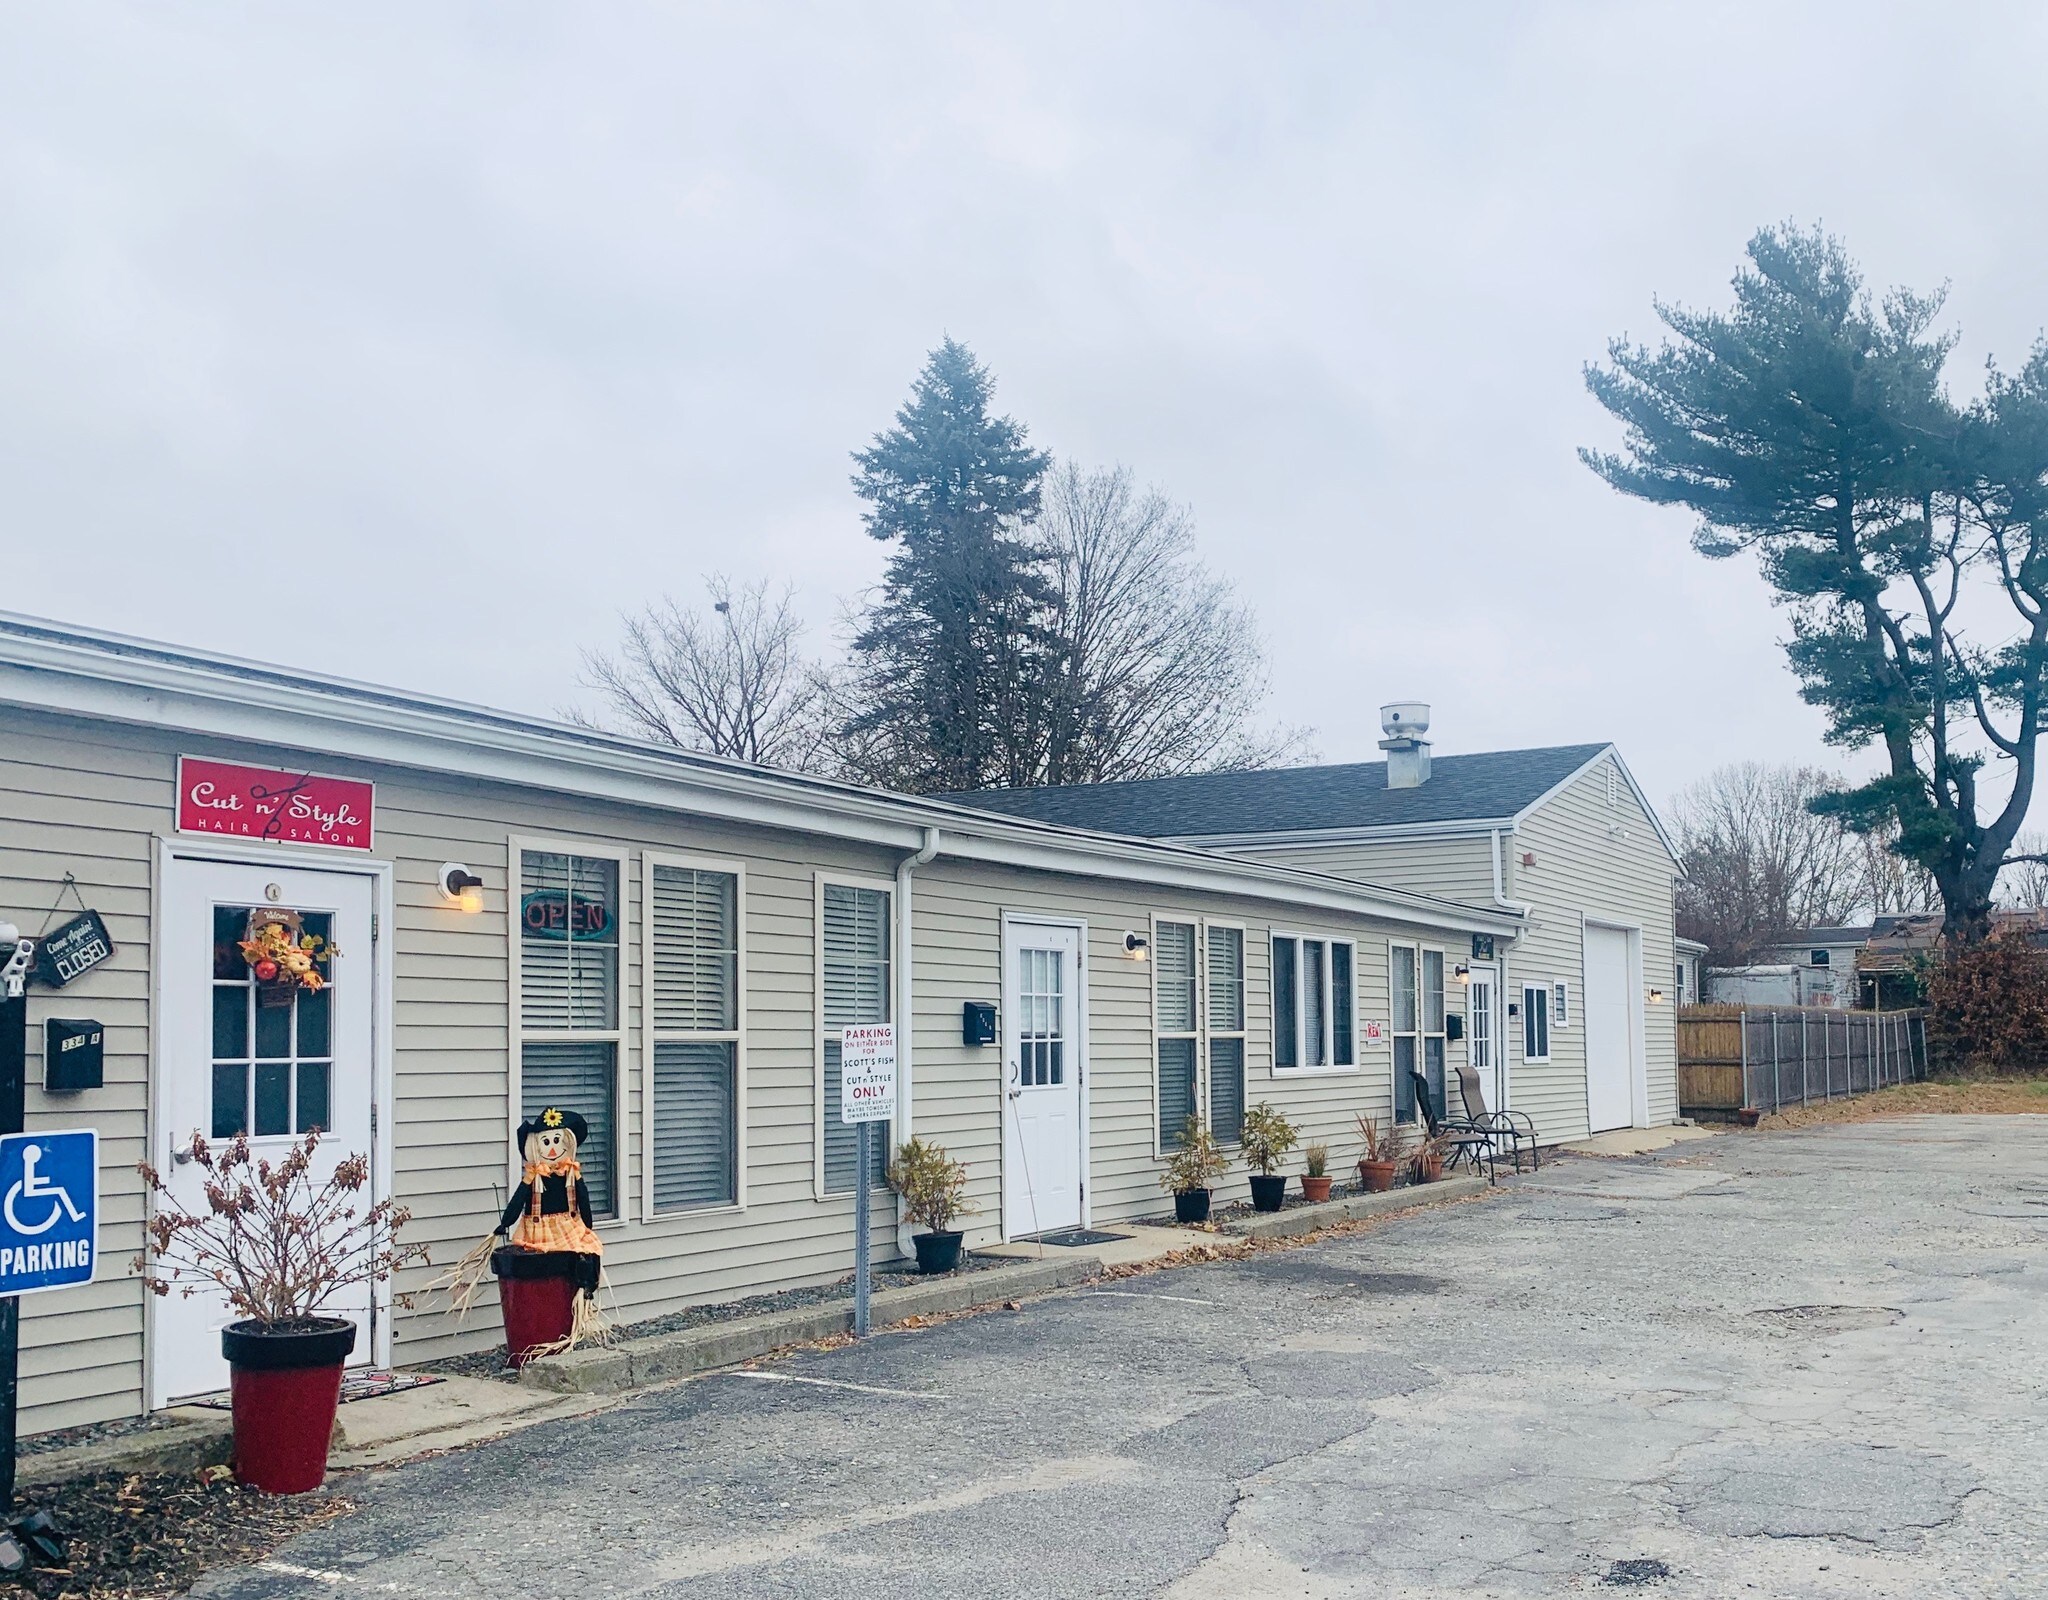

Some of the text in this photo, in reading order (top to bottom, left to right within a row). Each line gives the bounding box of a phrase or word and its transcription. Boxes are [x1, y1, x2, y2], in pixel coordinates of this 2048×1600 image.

[191, 781, 244, 811] Cut
[288, 794, 362, 832] Style
[198, 818, 354, 843] HAIR SALON
[526, 901, 604, 929] OPEN
[56, 939, 108, 981] CLOSED
[846, 1028, 891, 1039] PARKING
[844, 1057, 894, 1067] SCOTT'S FISH
[846, 1076, 861, 1085] CUT
[870, 1074, 891, 1083] STYLE
[853, 1085, 885, 1098] ONLY
[0, 1239, 90, 1276] PARKING
